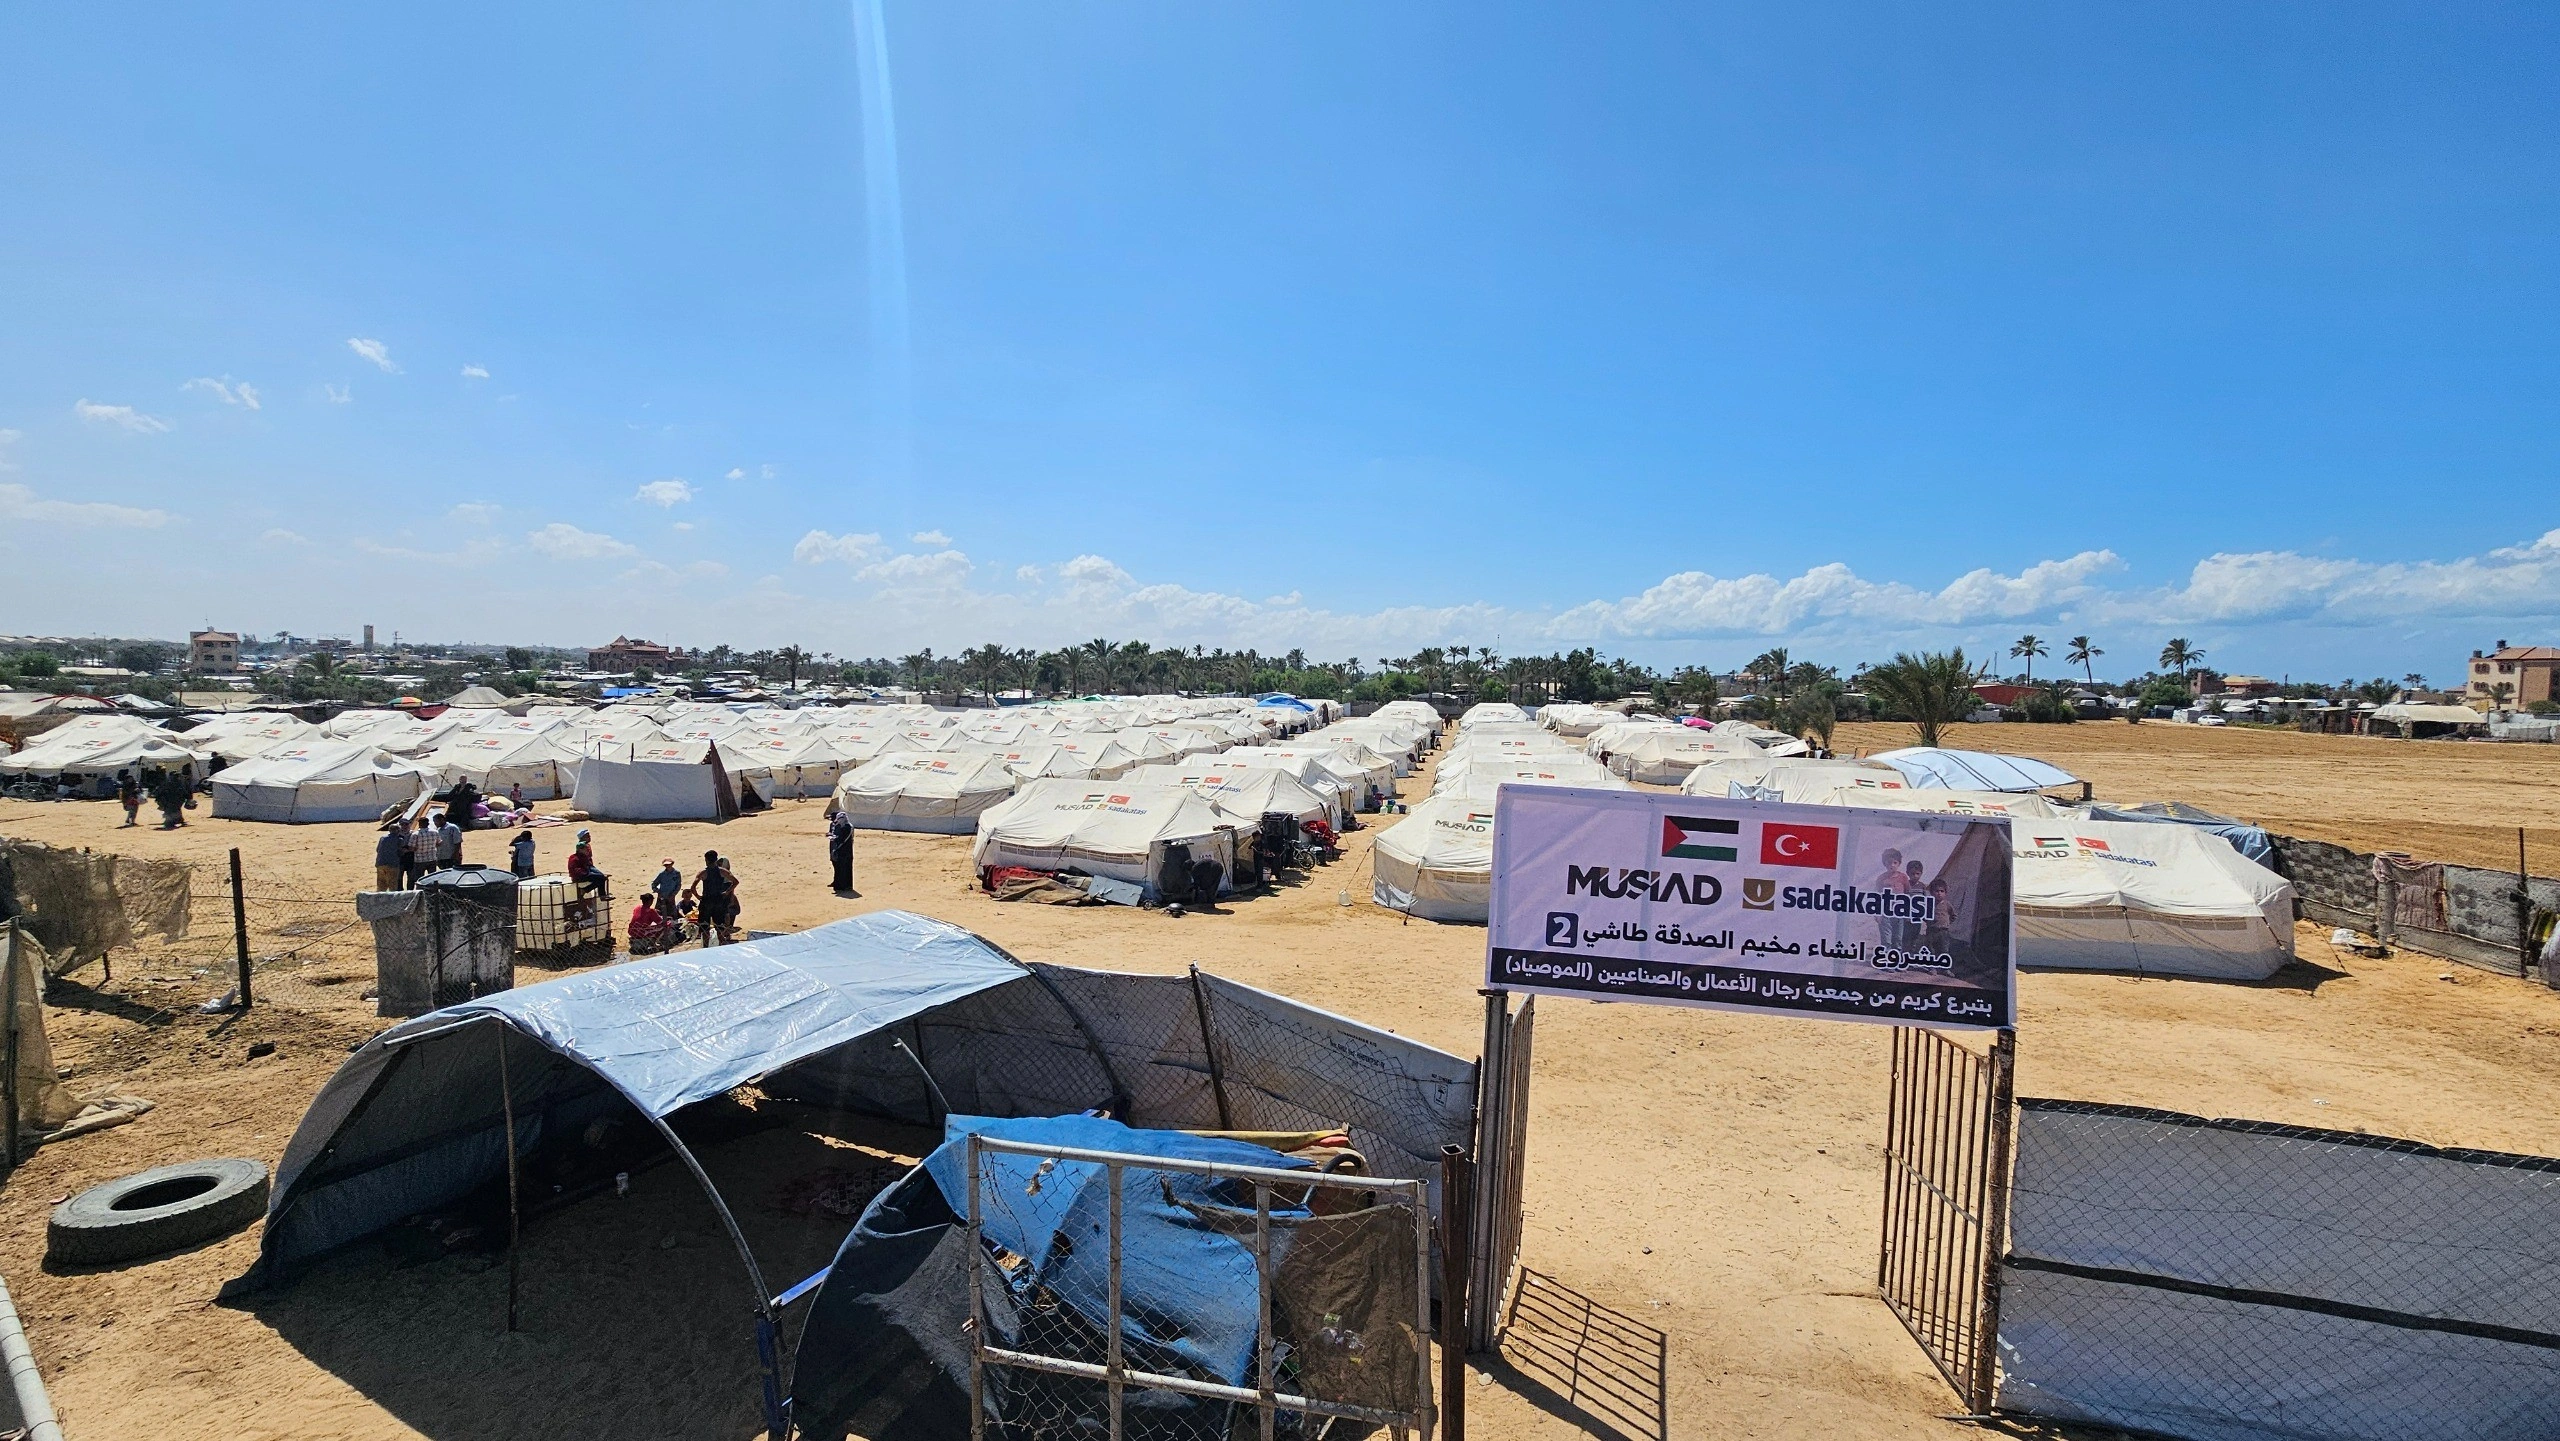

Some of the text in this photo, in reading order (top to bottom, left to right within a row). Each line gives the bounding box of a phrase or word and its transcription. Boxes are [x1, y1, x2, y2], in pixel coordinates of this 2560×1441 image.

[1782, 884, 1935, 922] sadakataşı
[1552, 916, 1952, 968] مشروع انشاء مخيم الصدقة طاشي 2
[1505, 955, 1992, 1017] بتبرع كريم من جمعية رجال الأعمال والصناعيين (الموصياد)
